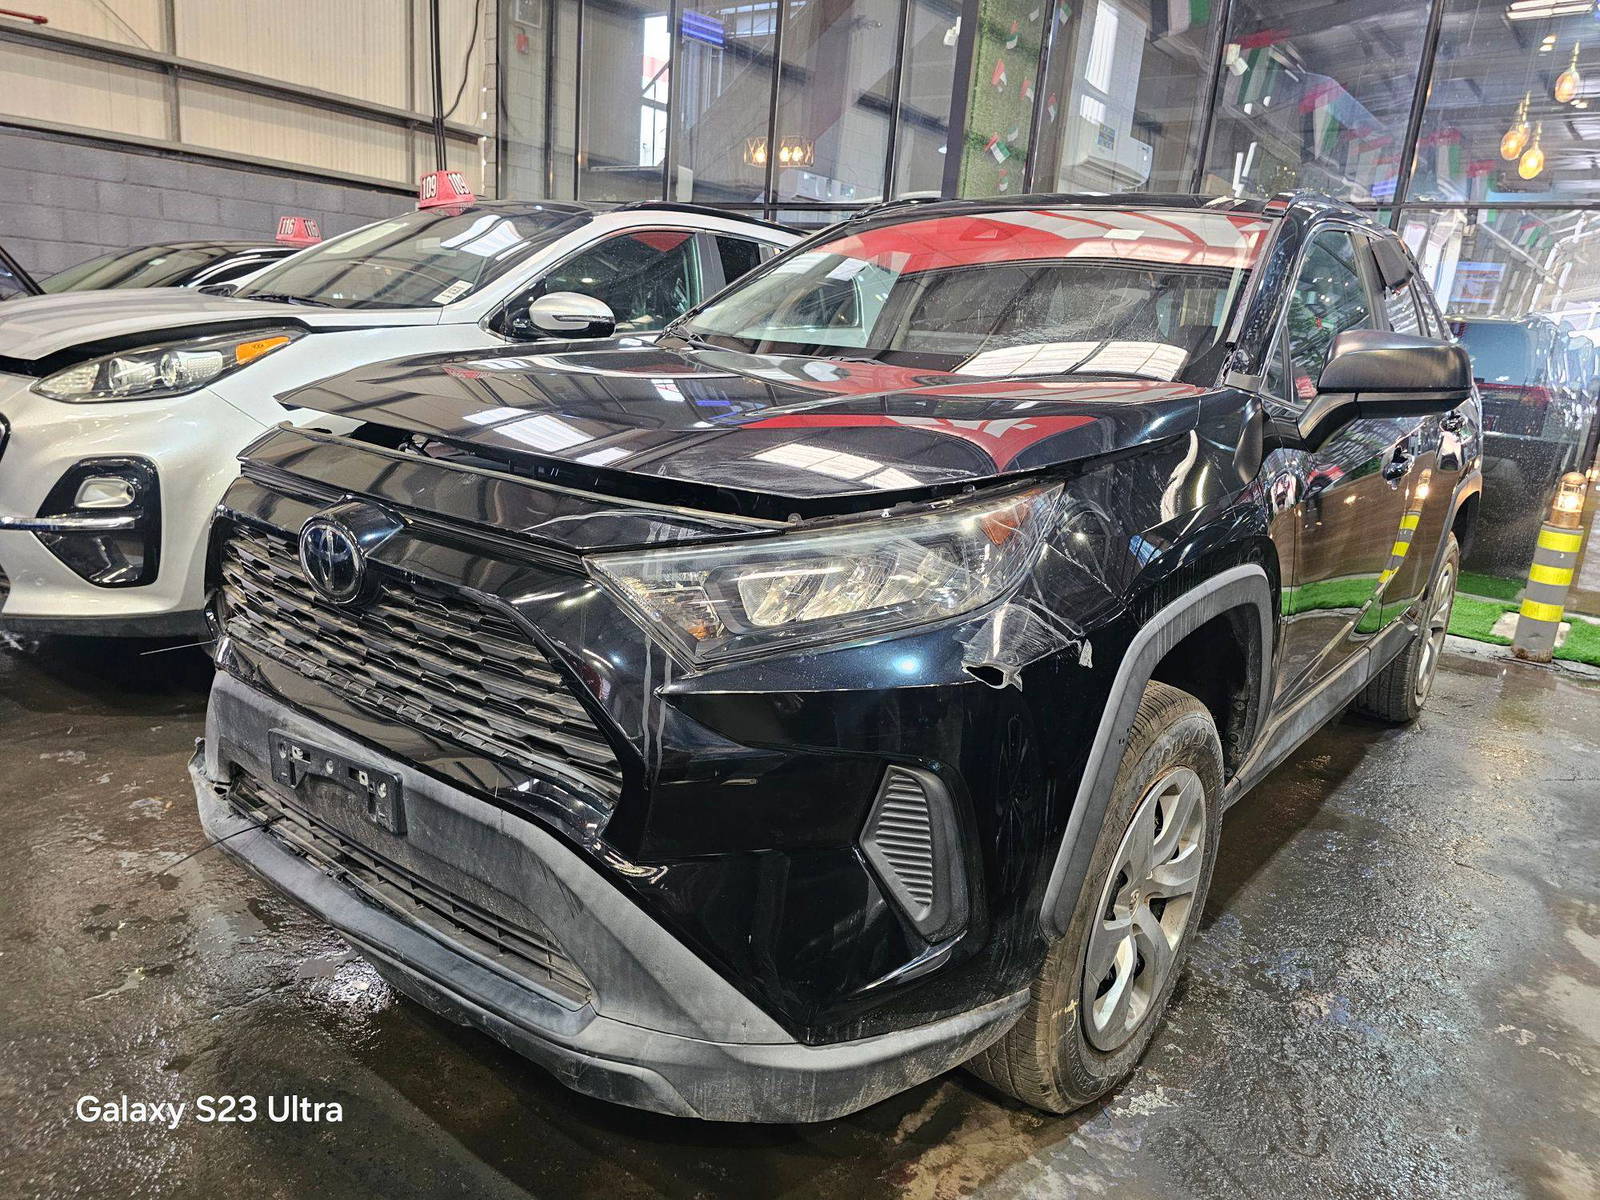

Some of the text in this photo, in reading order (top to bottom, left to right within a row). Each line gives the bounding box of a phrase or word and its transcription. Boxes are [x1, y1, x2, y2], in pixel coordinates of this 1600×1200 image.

[422, 174, 437, 200] 109
[447, 173, 470, 195] 109
[280, 218, 295, 235] 116
